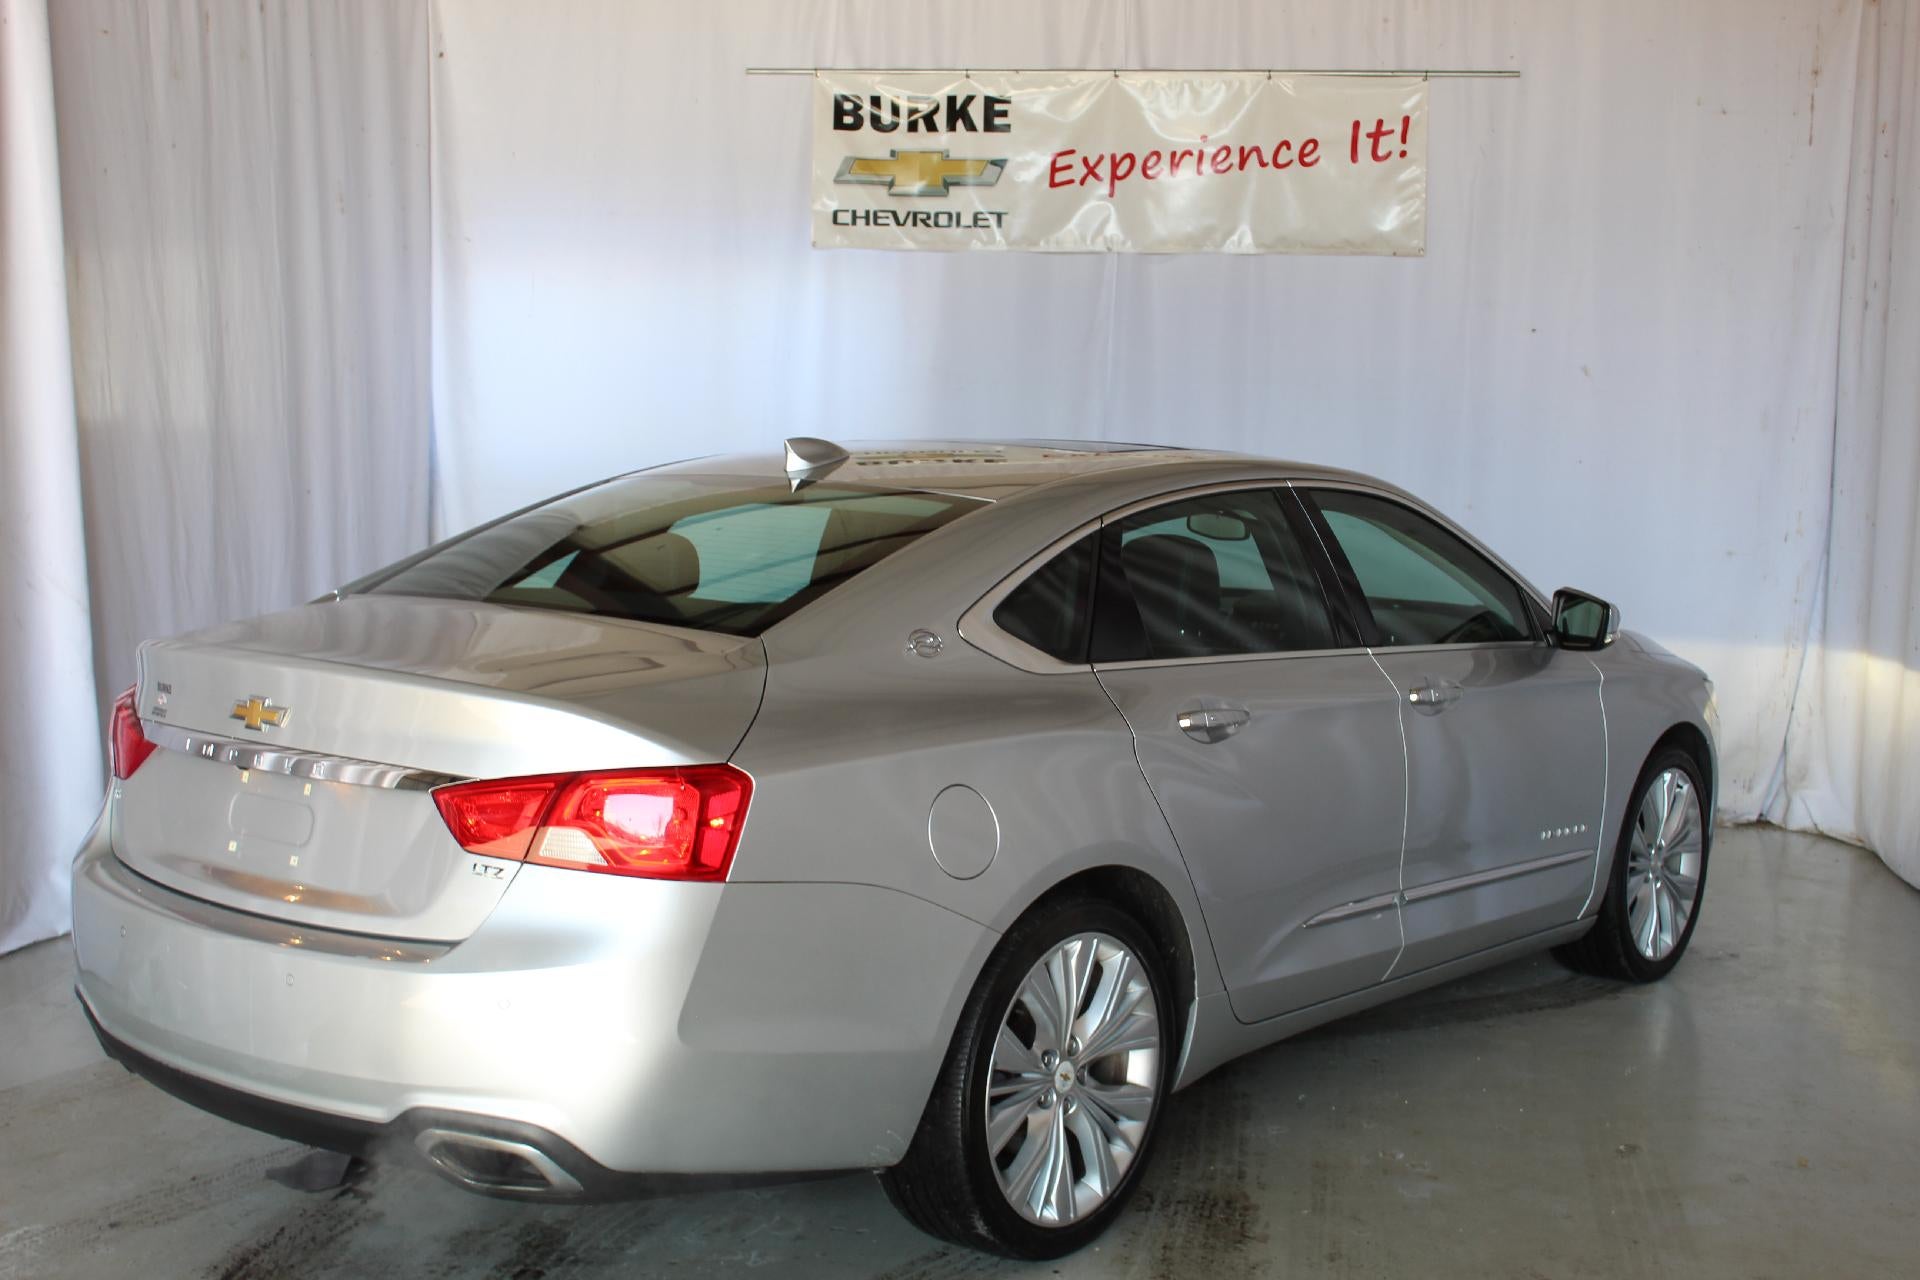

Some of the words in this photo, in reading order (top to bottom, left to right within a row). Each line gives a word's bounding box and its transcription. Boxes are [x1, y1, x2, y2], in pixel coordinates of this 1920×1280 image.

[833, 94, 1012, 133] BURKE
[1049, 134, 1320, 197] Experience
[1350, 115, 1411, 164] It!
[832, 209, 1008, 229] CHEVROLET
[472, 863, 504, 880] LTZ
